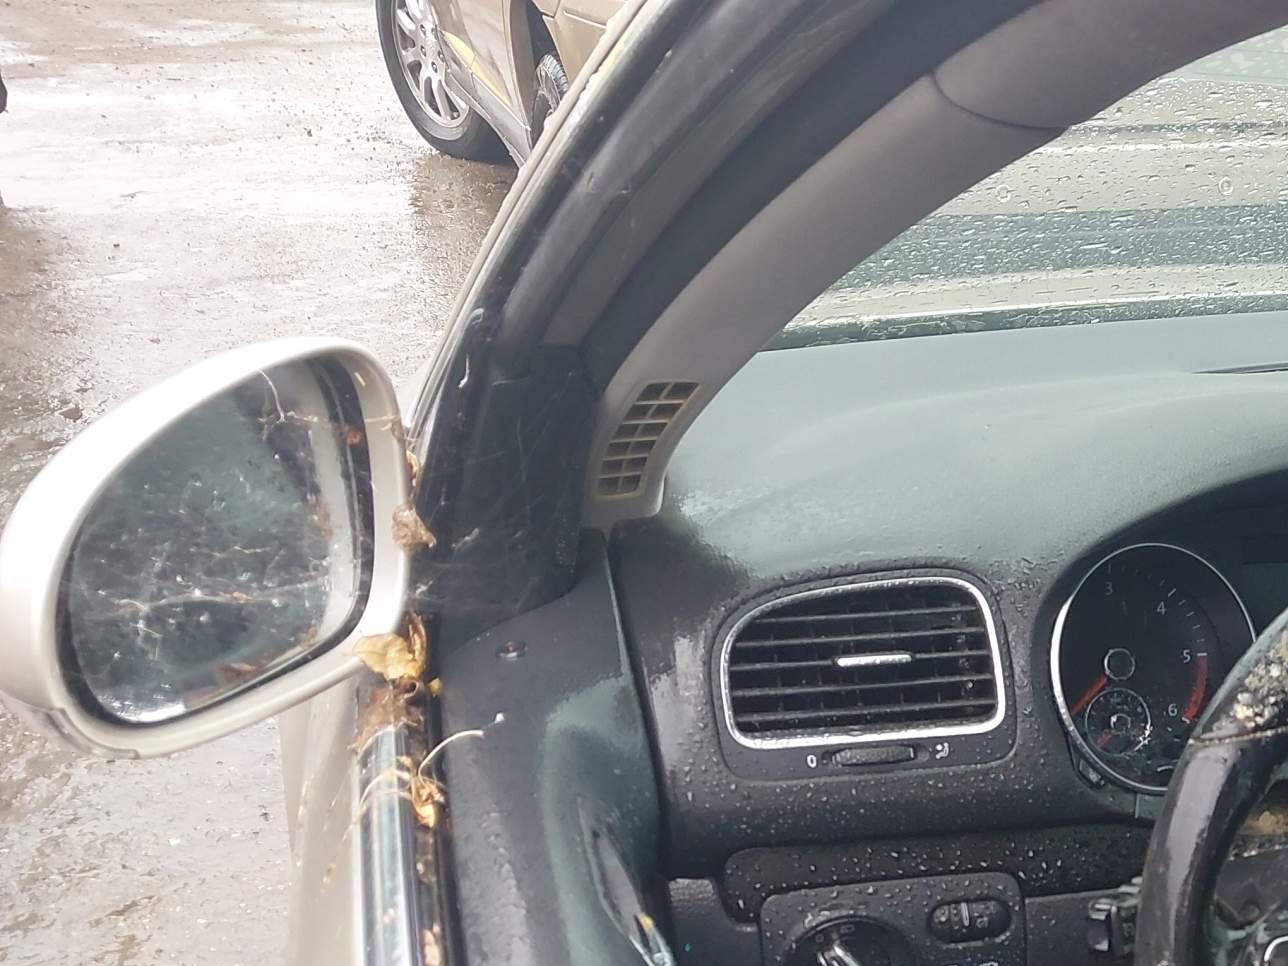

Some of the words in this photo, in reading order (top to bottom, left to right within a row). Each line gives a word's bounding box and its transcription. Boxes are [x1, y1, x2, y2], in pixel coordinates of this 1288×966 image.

[1105, 582, 1113, 595] 3
[1156, 602, 1167, 615] 4
[1183, 650, 1191, 662] 5
[1168, 703, 1178, 717] 6
[806, 754, 817, 768] 0
